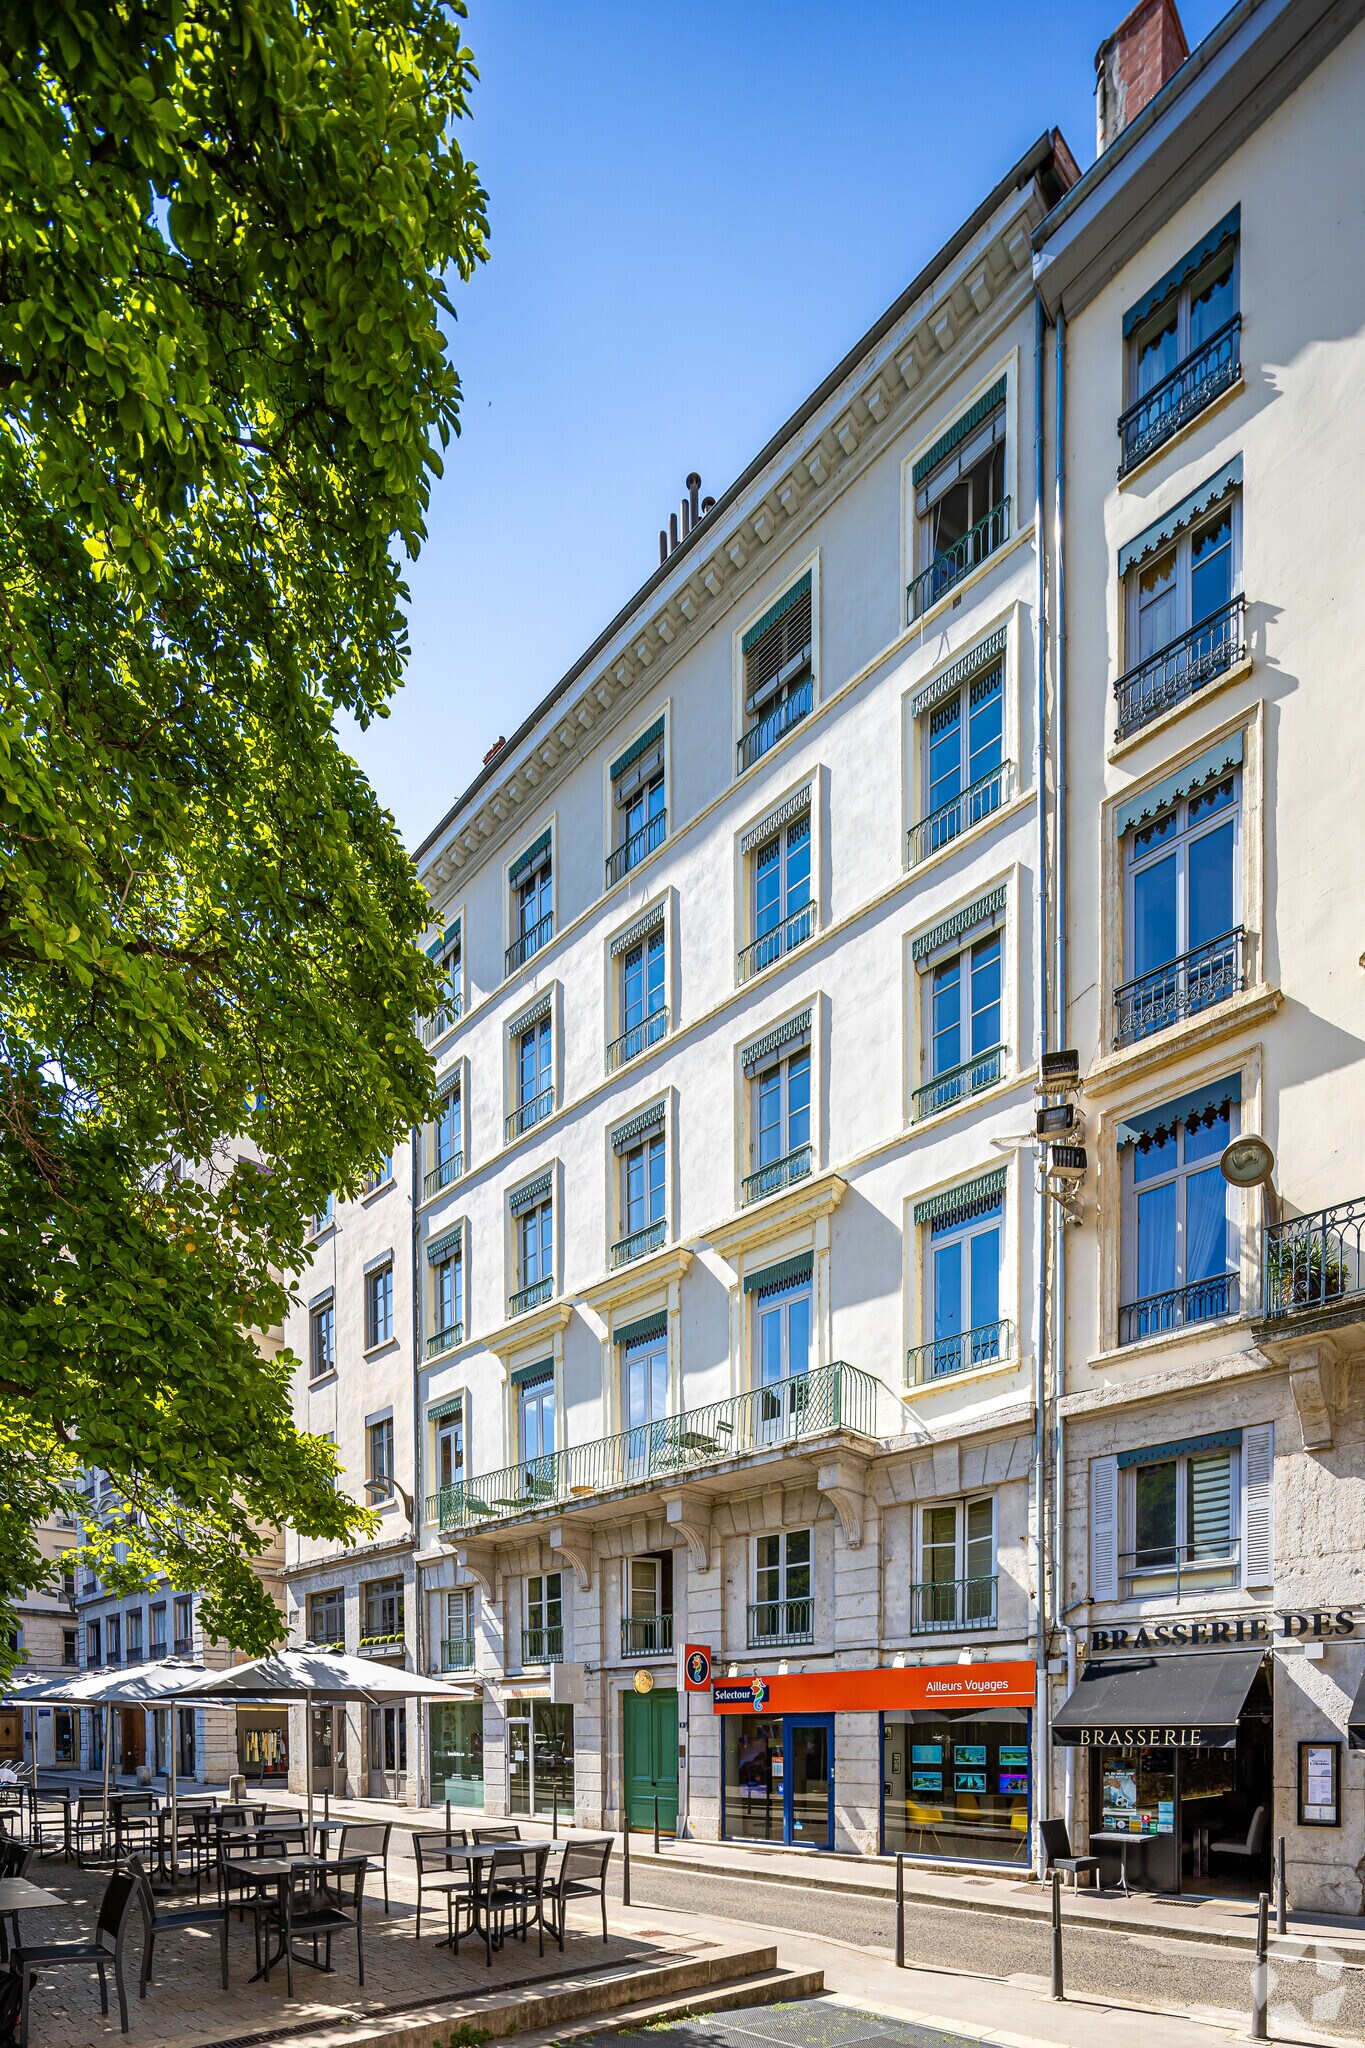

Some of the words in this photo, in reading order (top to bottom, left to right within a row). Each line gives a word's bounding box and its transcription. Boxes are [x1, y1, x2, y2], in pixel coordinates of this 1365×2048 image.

[1091, 1618, 1270, 1651] BRASSERIE
[1282, 1610, 1355, 1638] DES
[926, 1682, 962, 1692] Ailleurs
[964, 1680, 1009, 1692] Voyages
[715, 1690, 751, 1700] Selectour
[1080, 1729, 1201, 1746] BRASSERIE
